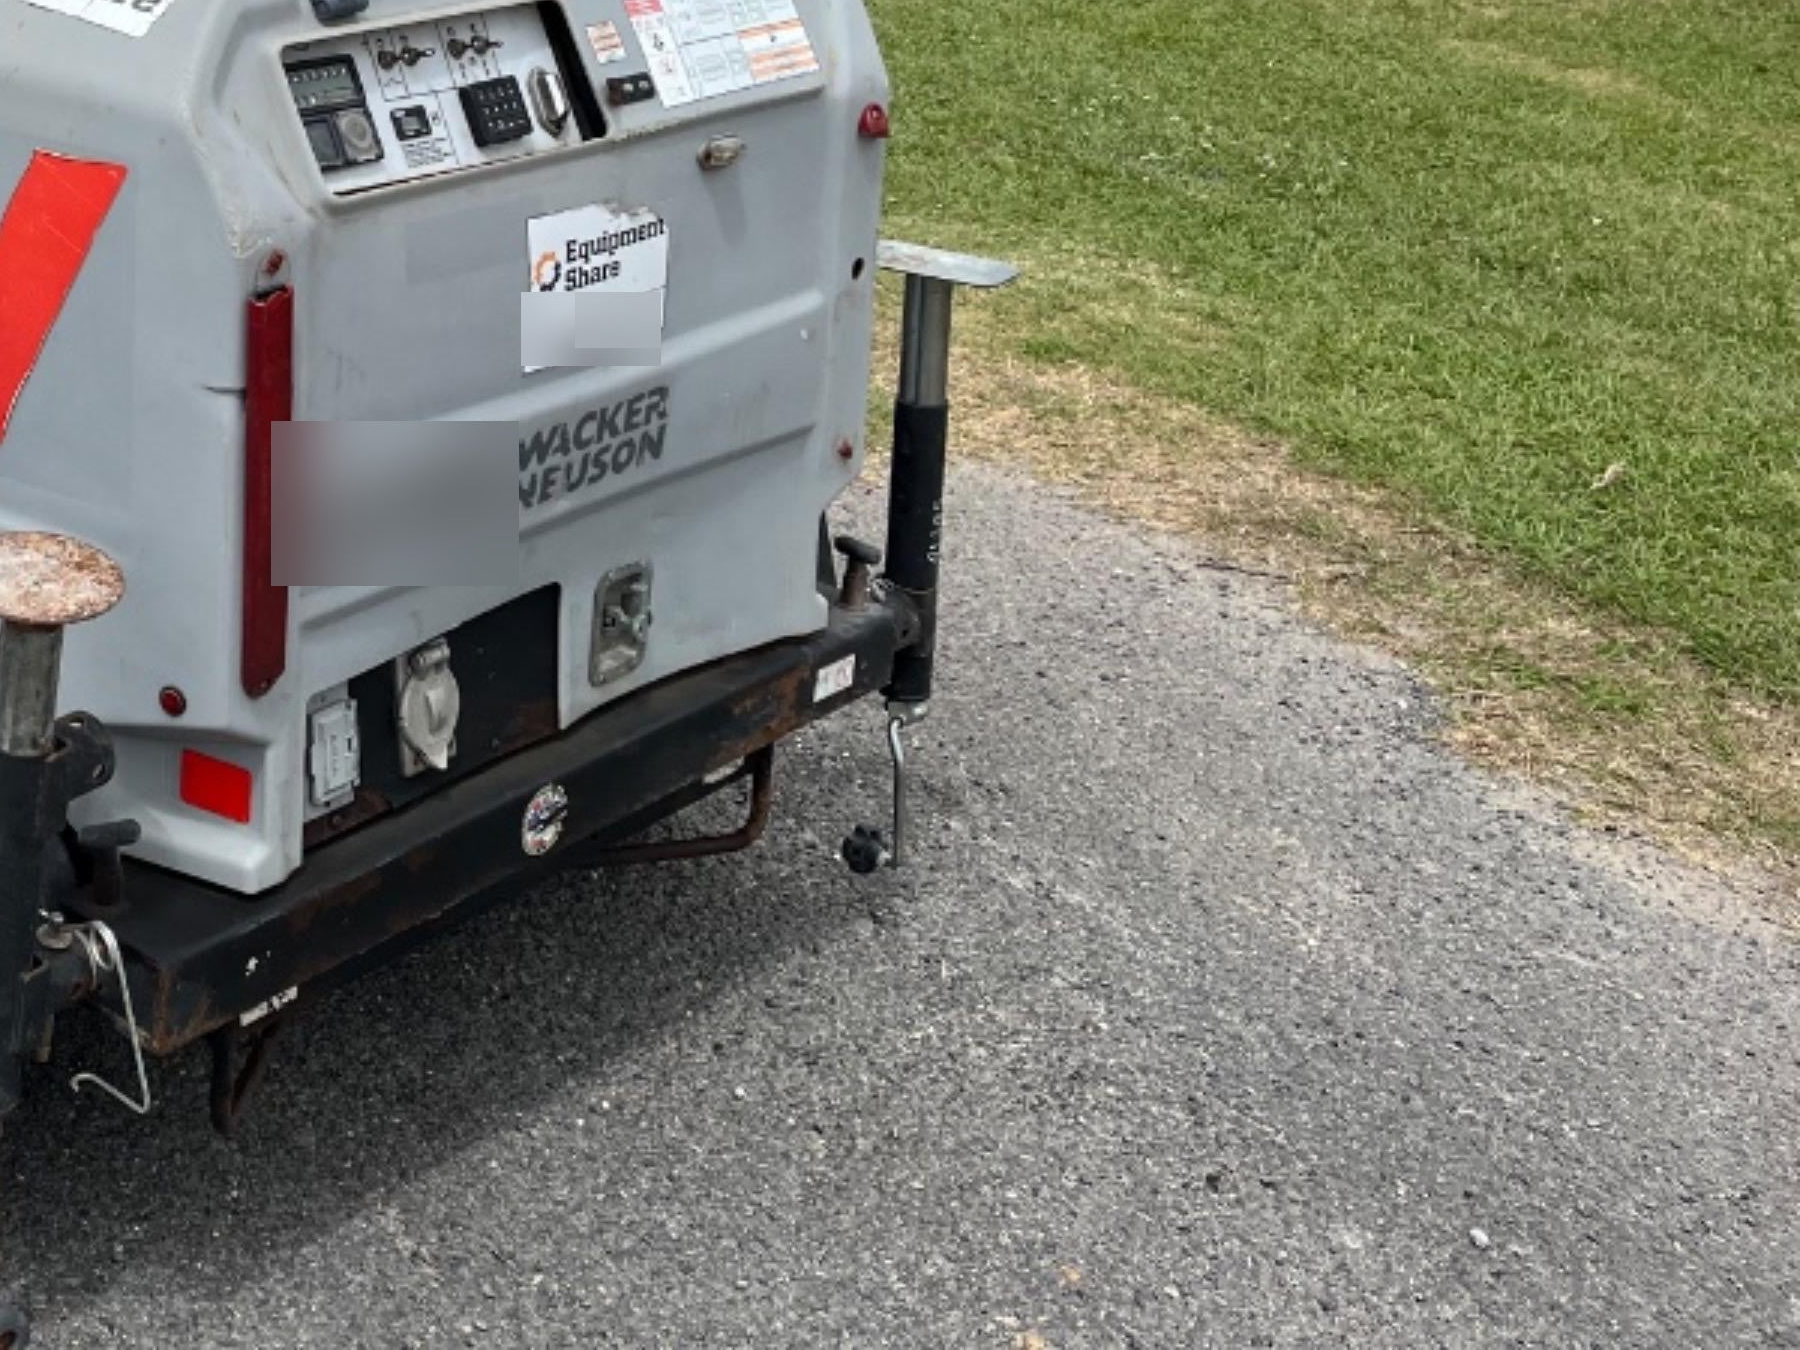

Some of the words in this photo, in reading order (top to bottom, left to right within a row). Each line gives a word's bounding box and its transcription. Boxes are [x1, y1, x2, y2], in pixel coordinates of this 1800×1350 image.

[565, 217, 665, 265] Equipment
[564, 260, 622, 292] Share
[518, 385, 670, 472] WACKER
